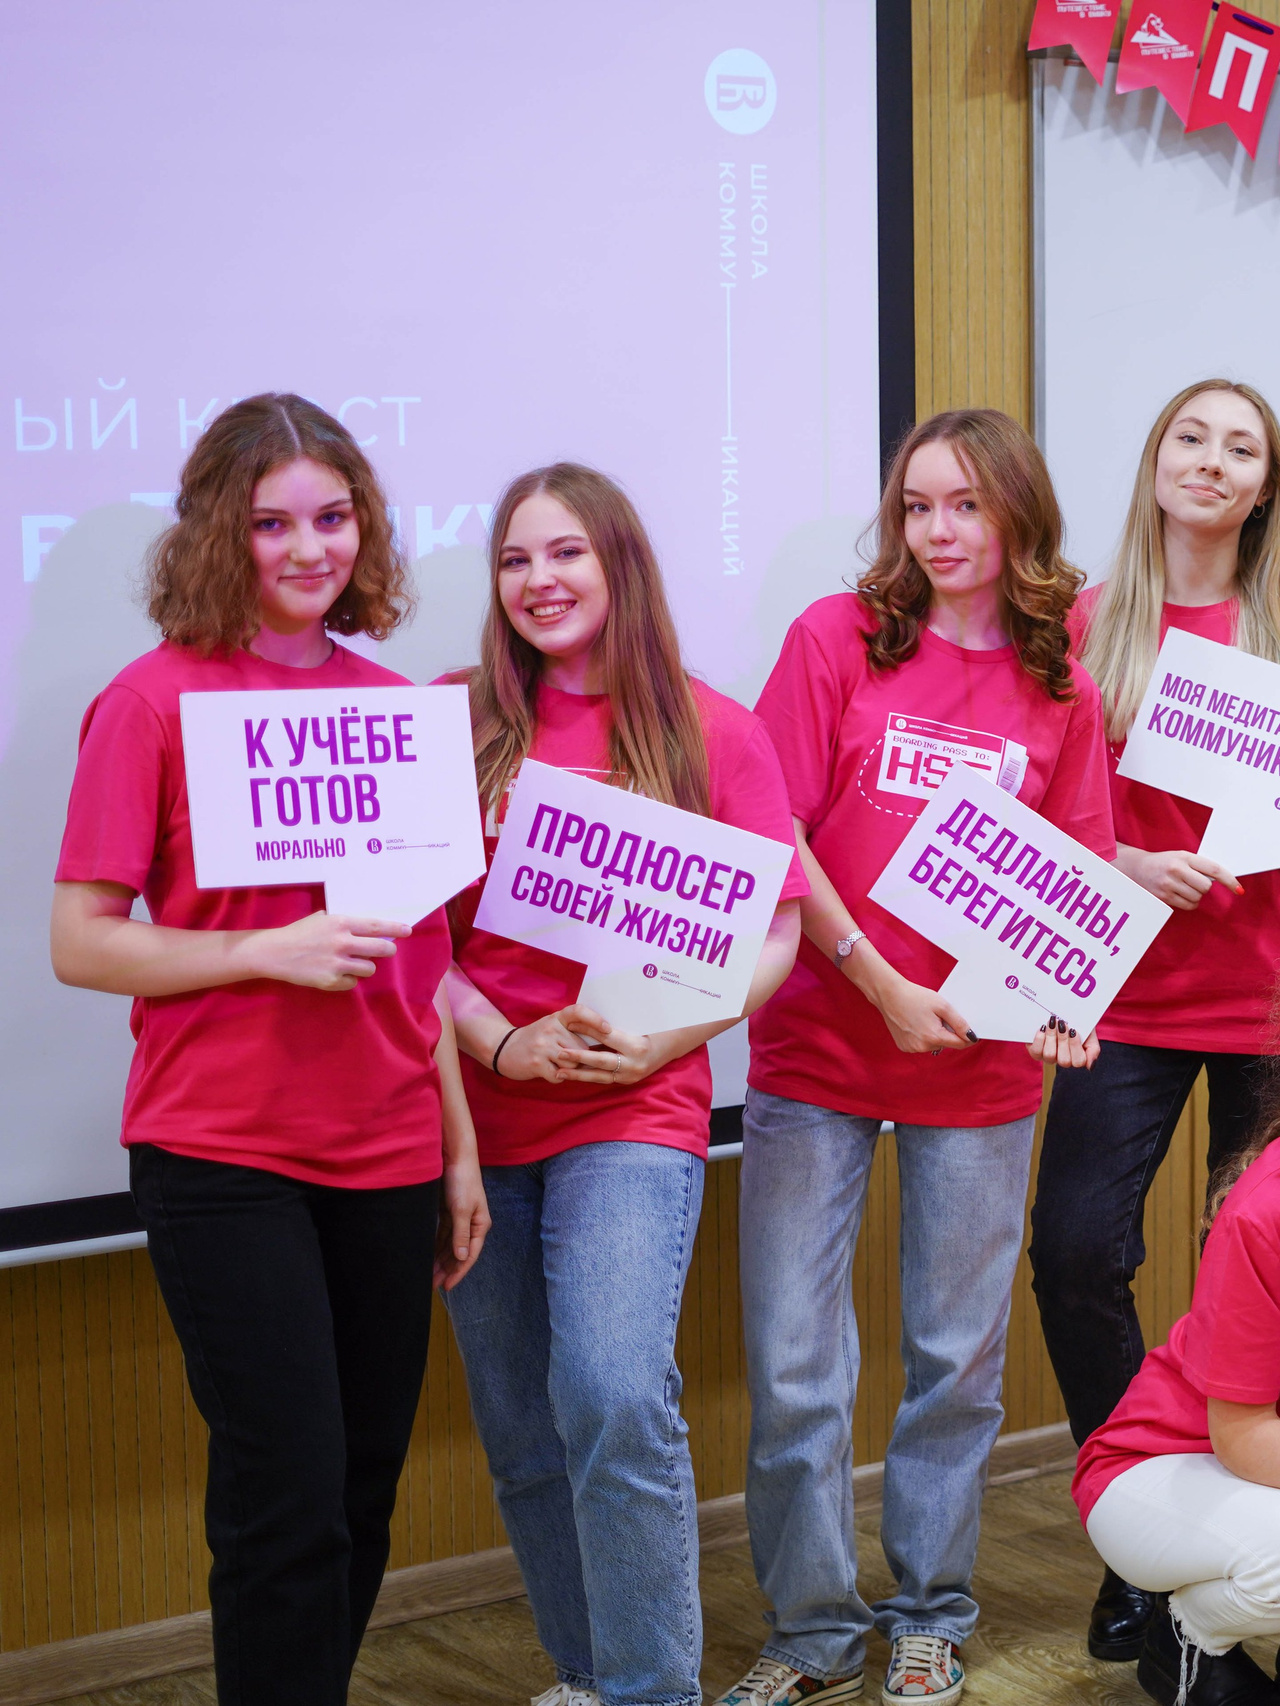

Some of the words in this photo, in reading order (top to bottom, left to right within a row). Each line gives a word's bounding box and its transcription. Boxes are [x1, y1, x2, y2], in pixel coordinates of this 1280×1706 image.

[751, 163, 769, 280] ШКОЛА
[1159, 672, 1207, 708] МОЯ
[244, 719, 274, 768] К
[281, 707, 417, 767] УЧЁБЕ
[886, 746, 992, 789] HS
[893, 735, 938, 751] BOARDING
[942, 745, 968, 757] PASS
[975, 751, 990, 760] TO:
[250, 773, 381, 828] ГОТОВ
[255, 837, 346, 861] МОРАЛЬНО
[526, 803, 756, 914] ПРОДЮСЕР
[935, 798, 1130, 957] ДЕДЛАЙНЫ,
[511, 865, 614, 928] СВОЕЙ
[614, 899, 734, 968] ЖИЗНИ
[908, 843, 1097, 998] БЕРЕГИТЕСЬ
